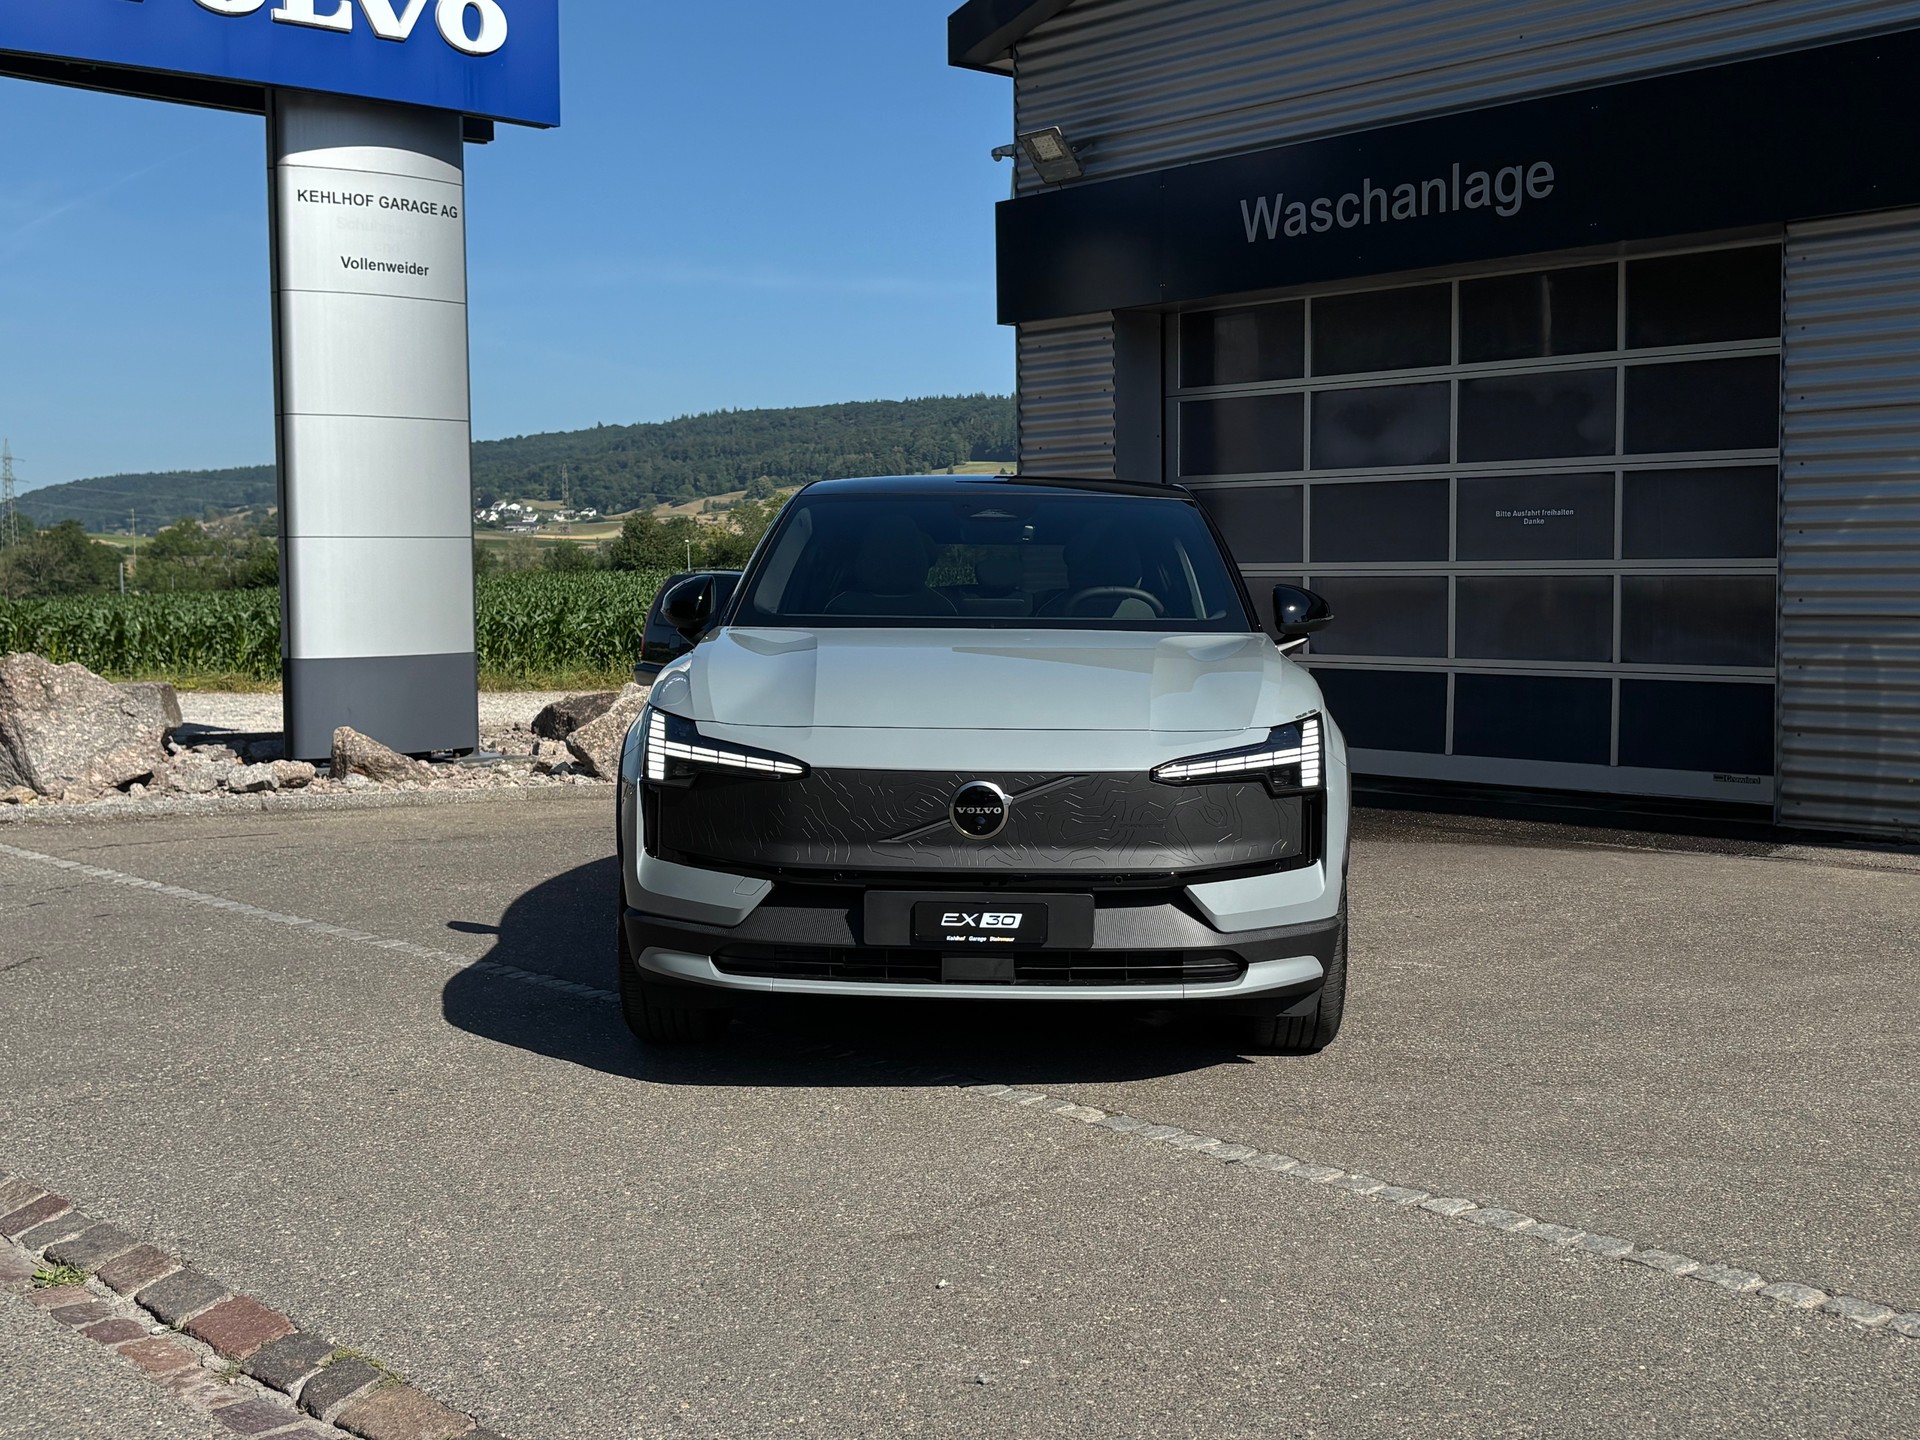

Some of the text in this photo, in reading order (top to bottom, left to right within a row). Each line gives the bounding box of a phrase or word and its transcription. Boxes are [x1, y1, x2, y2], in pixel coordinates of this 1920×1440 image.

[125, 0, 509, 56] LVO
[297, 189, 459, 219] KEHLHOF GARAGE AG
[1240, 161, 1555, 243] Waschanlage
[340, 256, 430, 277] Vollenweider
[1495, 508, 1574, 518] Bitte Ausfahrt freihalten
[955, 806, 1002, 814] VOLVO
